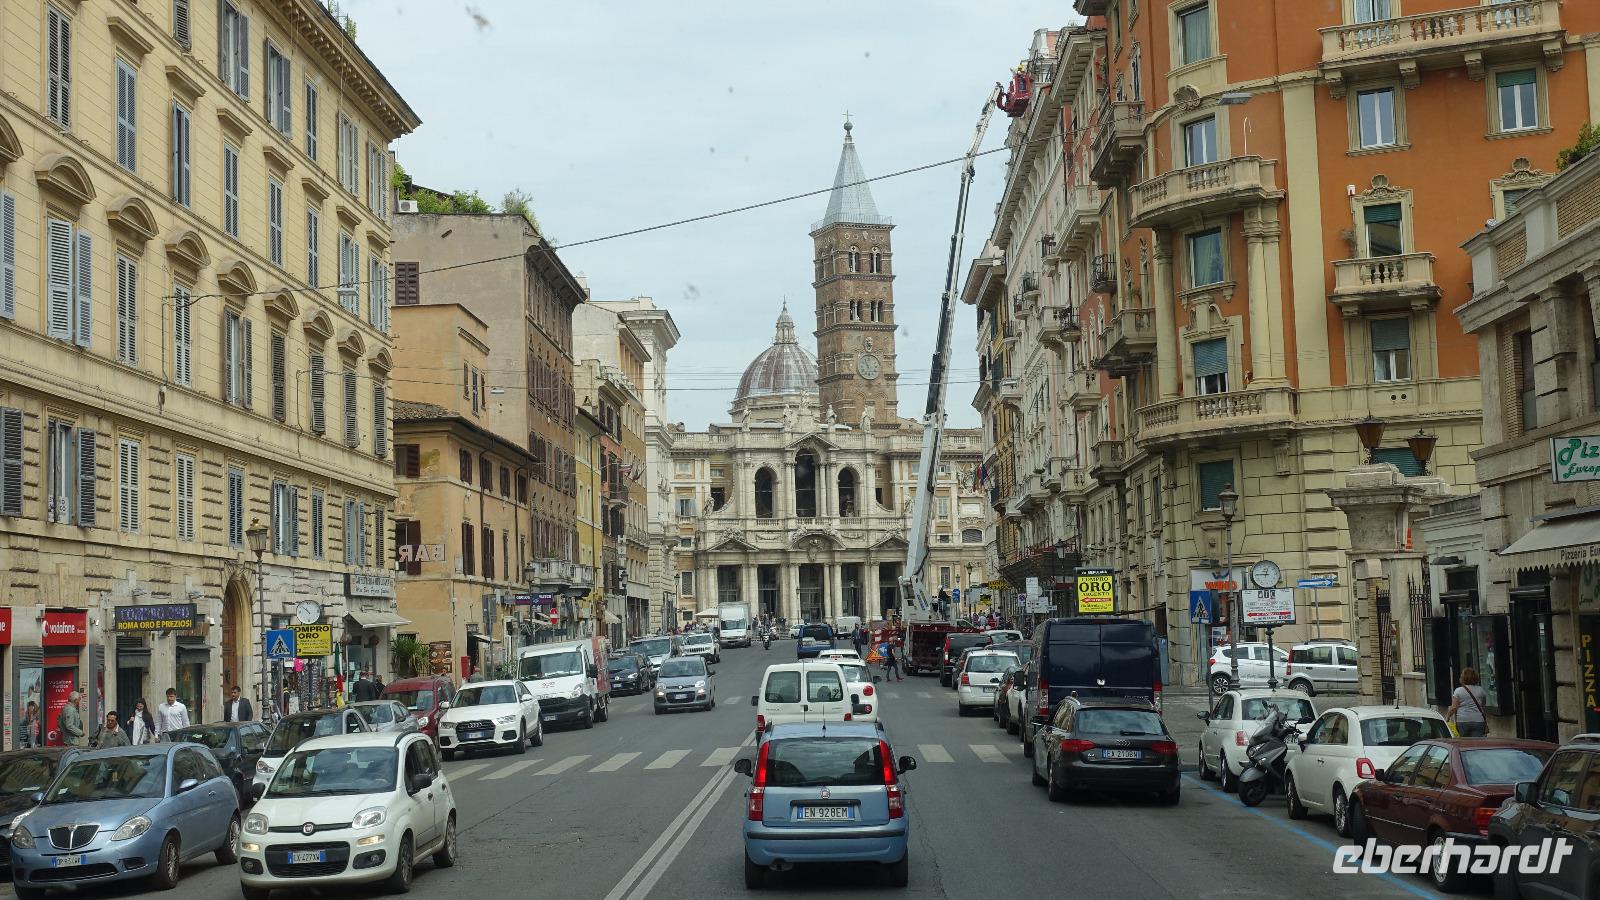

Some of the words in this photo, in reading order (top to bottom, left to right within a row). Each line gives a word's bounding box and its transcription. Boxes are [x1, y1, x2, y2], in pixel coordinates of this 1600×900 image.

[1079, 582, 1112, 592] ORO
[49, 621, 76, 634] vodafone
[118, 621, 139, 630] ROMA
[140, 621, 155, 629] ORO
[156, 620, 161, 628] E
[161, 619, 192, 628] PREZIOSI
[1581, 634, 1597, 708] PIZZA
[804, 807, 817, 818] EN
[819, 807, 848, 818] 928EM
